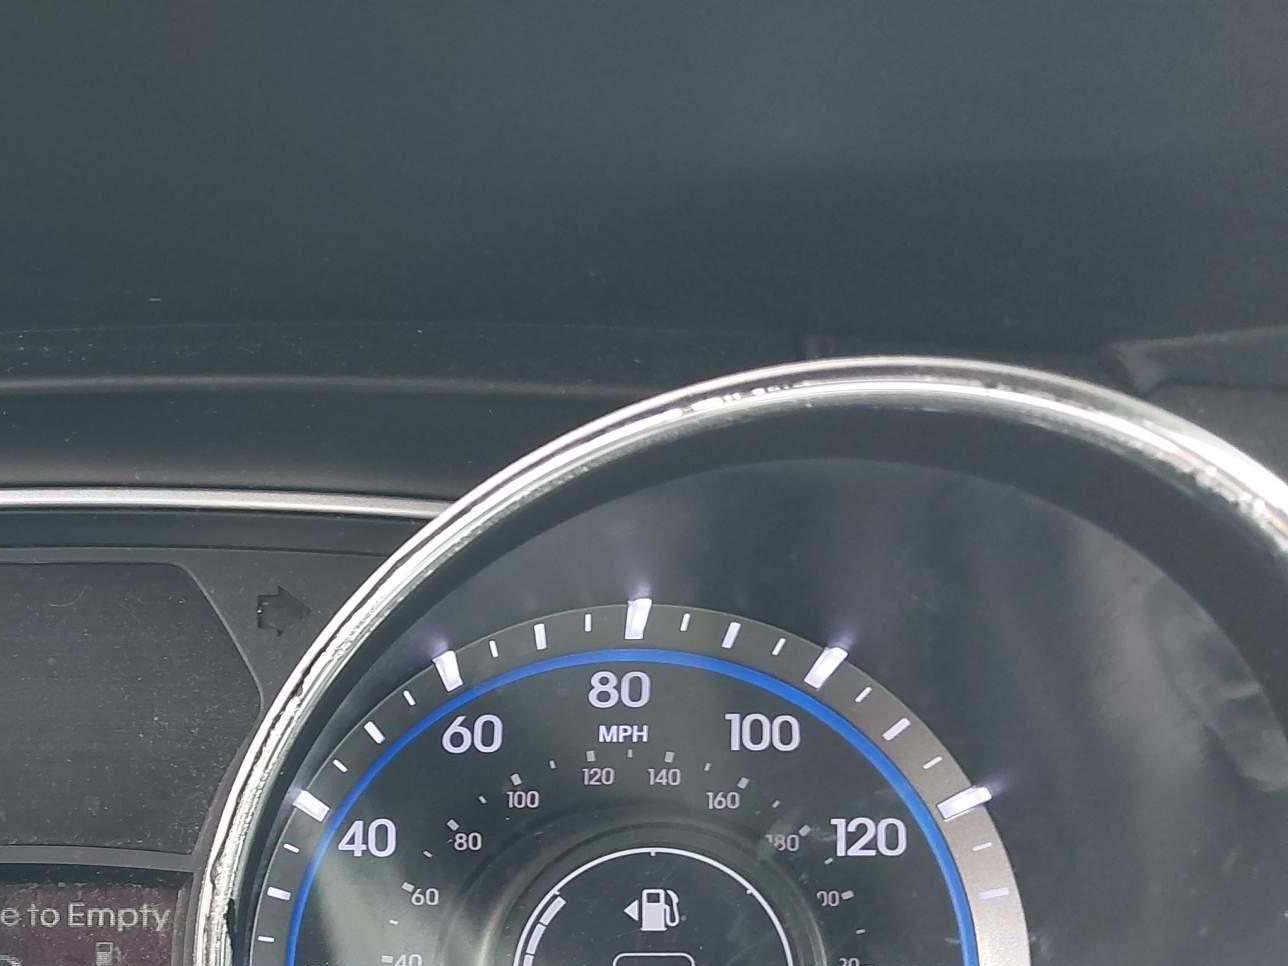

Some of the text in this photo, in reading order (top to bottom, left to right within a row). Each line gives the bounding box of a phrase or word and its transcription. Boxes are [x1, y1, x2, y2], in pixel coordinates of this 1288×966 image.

[588, 671, 651, 708] 80
[441, 713, 503, 753] 60
[598, 725, 648, 743] MPH
[725, 713, 801, 751] 100
[582, 768, 615, 786] 120
[648, 768, 681, 786] 140
[506, 791, 540, 809] 100
[706, 791, 740, 809] 160
[338, 818, 396, 858] 40
[454, 833, 482, 851] 80
[830, 817, 907, 857] 120
[411, 888, 439, 906] 60
[29, 905, 60, 928] to
[68, 902, 170, 932] Empty
